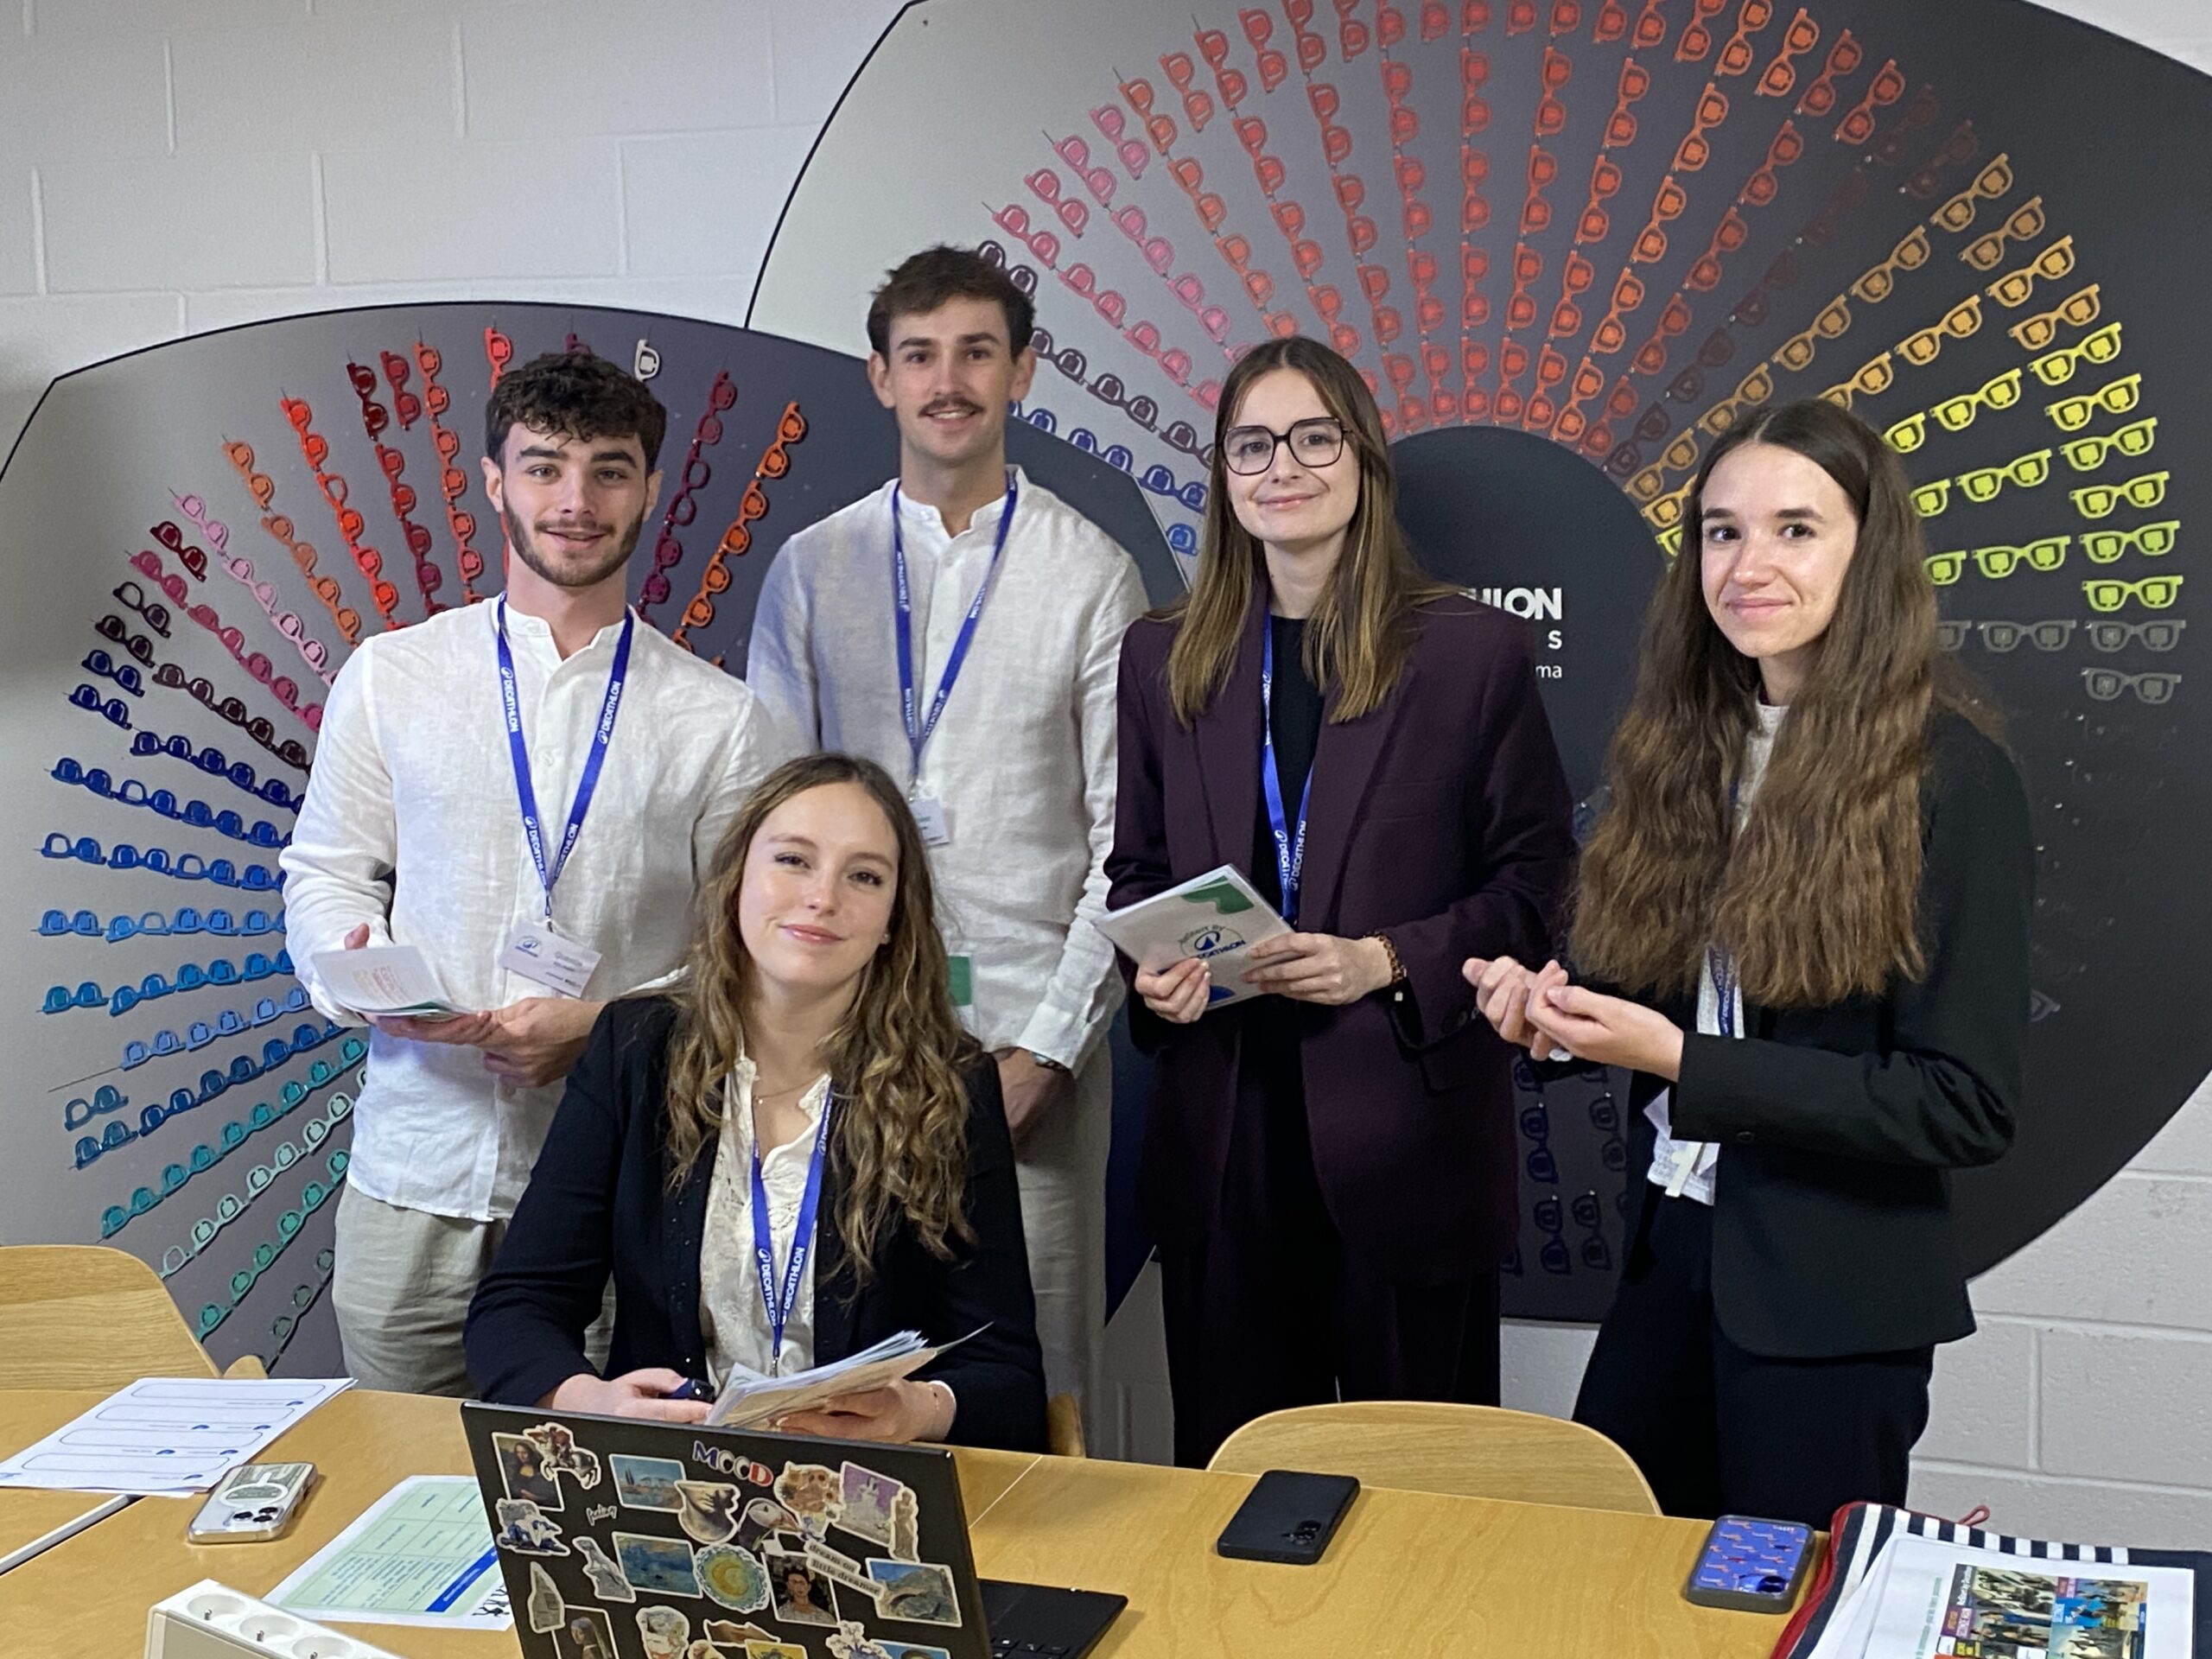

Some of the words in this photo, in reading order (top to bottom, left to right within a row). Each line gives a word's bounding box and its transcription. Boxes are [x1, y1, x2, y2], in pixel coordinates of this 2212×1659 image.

[503, 677, 519, 734] DECATHLON
[602, 680, 621, 733] DECATHLON
[761, 1264, 777, 1326] DECATHLON
[784, 1247, 805, 1310] DECATHLON
[809, 1543, 841, 1564] dream
[842, 1560, 856, 1573] on
[812, 1558, 836, 1575] little
[837, 1572, 880, 1594] dreamer
